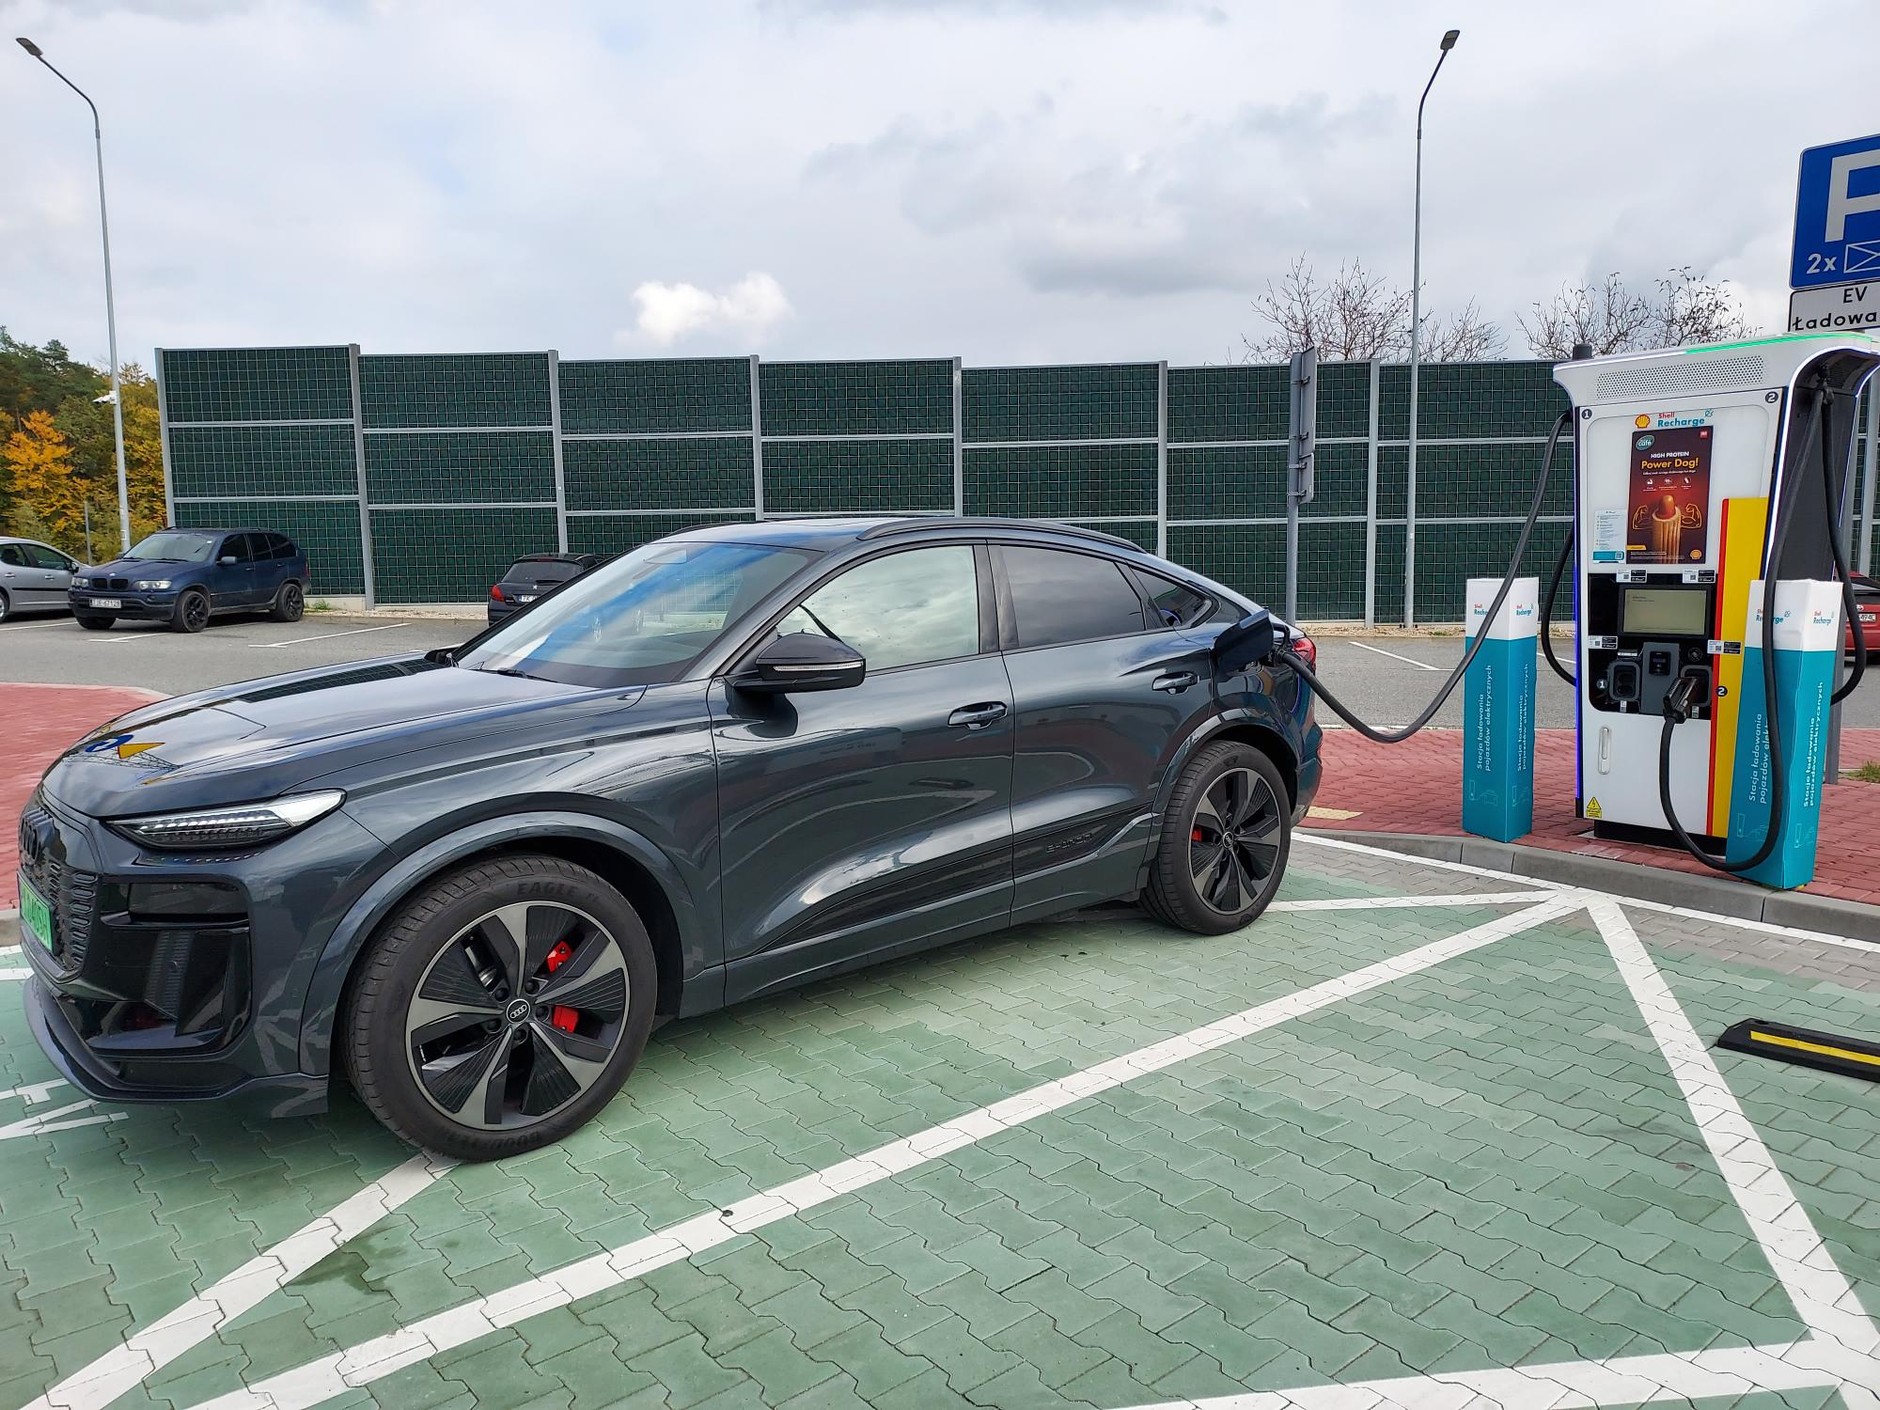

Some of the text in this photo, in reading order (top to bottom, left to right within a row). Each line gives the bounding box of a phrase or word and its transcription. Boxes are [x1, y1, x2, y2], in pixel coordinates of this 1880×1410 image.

[1805, 253, 1837, 275] 2x
[1843, 286, 1868, 304] EV
[1657, 417, 1705, 428] Recharge
[1658, 411, 1675, 419] Shell
[1641, 457, 1700, 470] Power Dog!
[1484, 664, 1493, 726] elektrycznych
[1476, 743, 1484, 770] Stacja
[1748, 713, 1762, 802] Stacja ładowania
[1759, 754, 1769, 805] pojazdów
[517, 881, 578, 897] EAGLE
